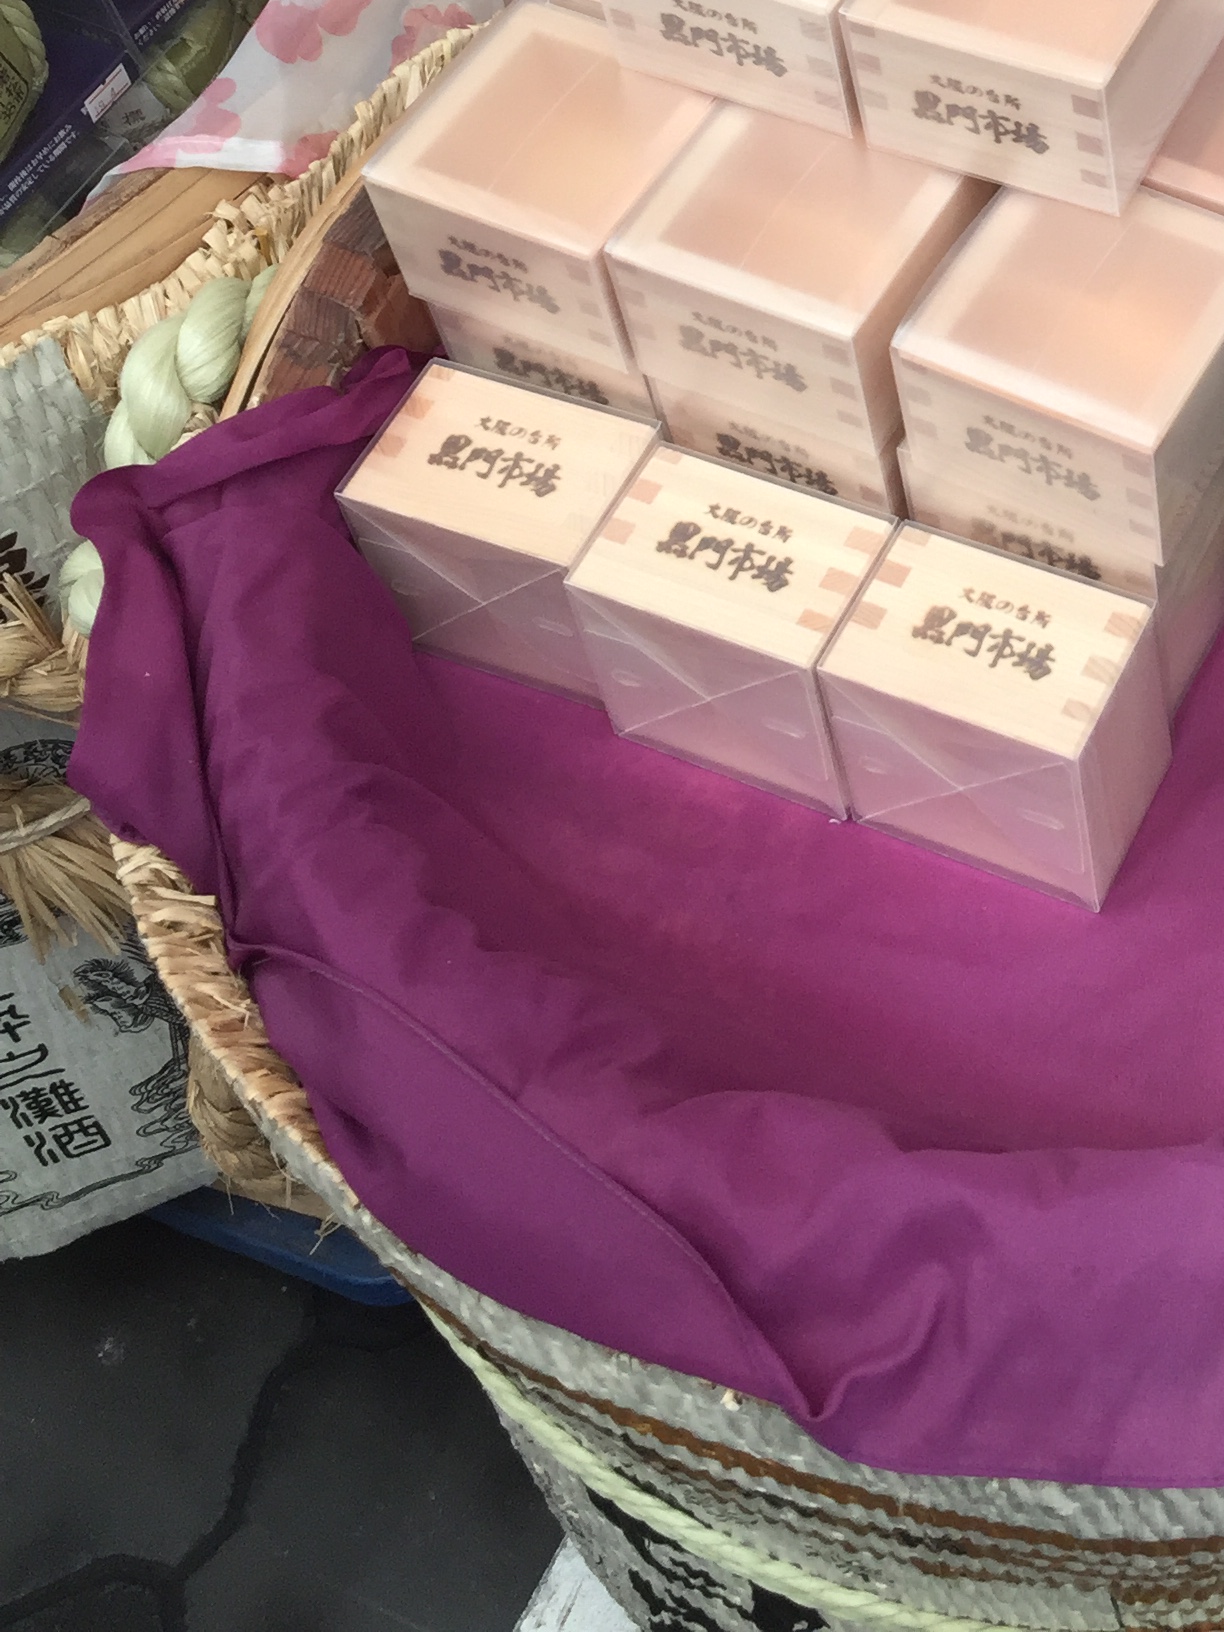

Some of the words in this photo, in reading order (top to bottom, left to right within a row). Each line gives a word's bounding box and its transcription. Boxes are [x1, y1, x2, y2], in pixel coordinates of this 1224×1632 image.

[659, 12, 788, 78] 黒門市場
[911, 89, 1050, 155] 黒門市場
[438, 246, 561, 315] 黒門市場
[427, 433, 563, 499] 黒門市場
[475, 415, 562, 451] 大阪の台所
[703, 501, 794, 544] 大阪の台所
[656, 520, 795, 593] 黒門市場
[959, 586, 1053, 629] 大阪の台所
[911, 604, 1057, 682] 黒門市場
